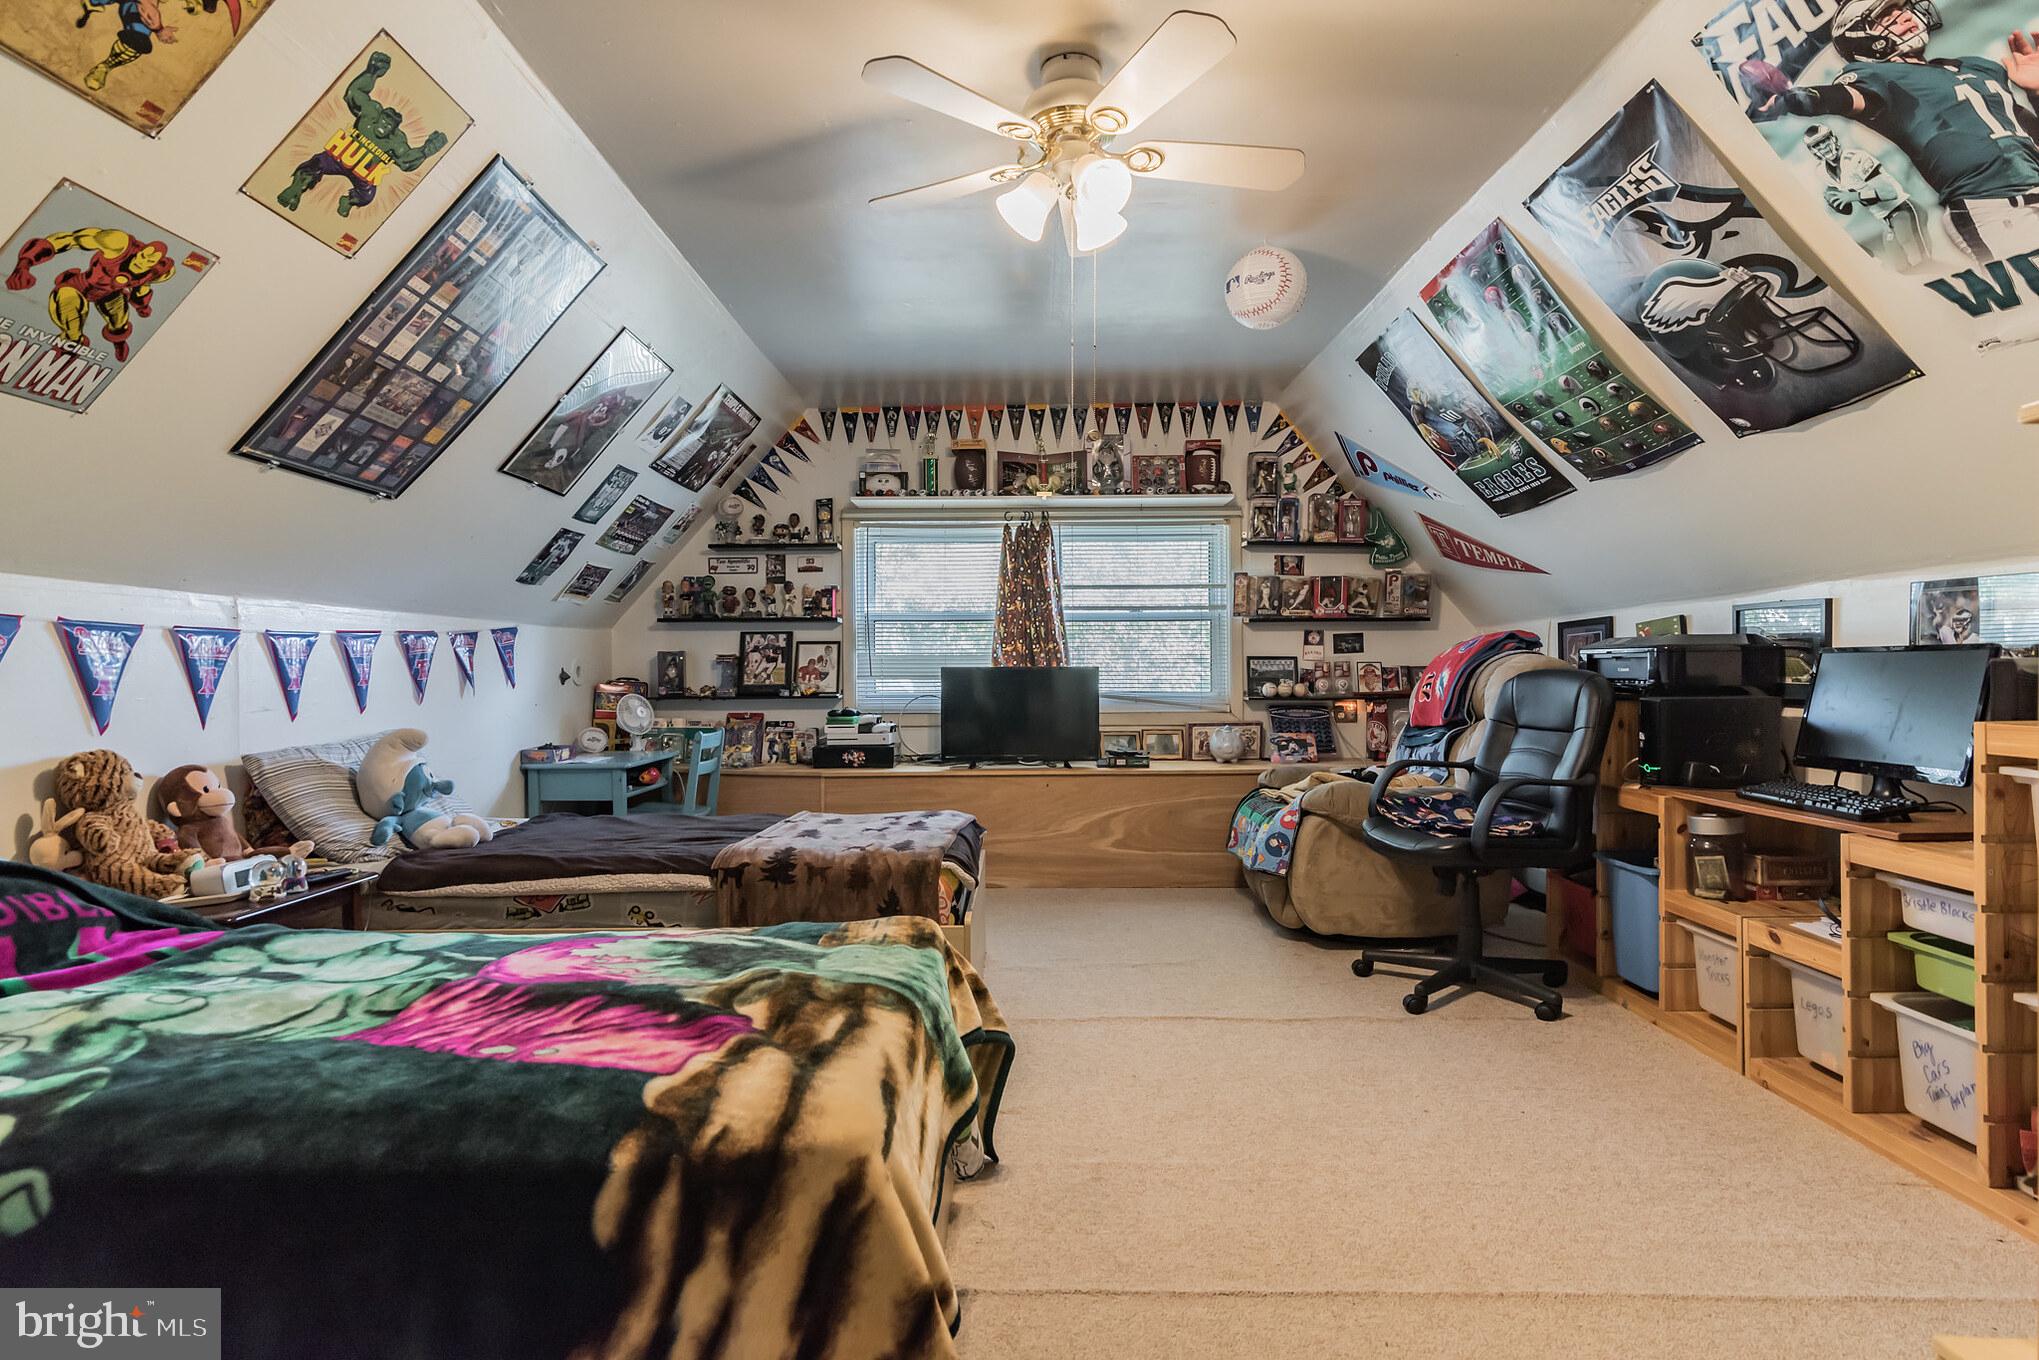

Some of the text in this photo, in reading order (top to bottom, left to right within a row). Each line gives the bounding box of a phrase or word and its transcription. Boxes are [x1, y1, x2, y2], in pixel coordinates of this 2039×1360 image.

[324, 128, 391, 186] HULK
[1580, 152, 1676, 238] EAGLES
[18, 325, 108, 361] INVINCIBLE
[17, 349, 112, 406] MAN
[1473, 456, 1547, 499] EAGLES
[1454, 537, 1526, 570] TEMPLE
[1801, 997, 1833, 1019] Legos
[1912, 1040, 1935, 1066] Big
[1923, 1059, 1950, 1083] Cars
